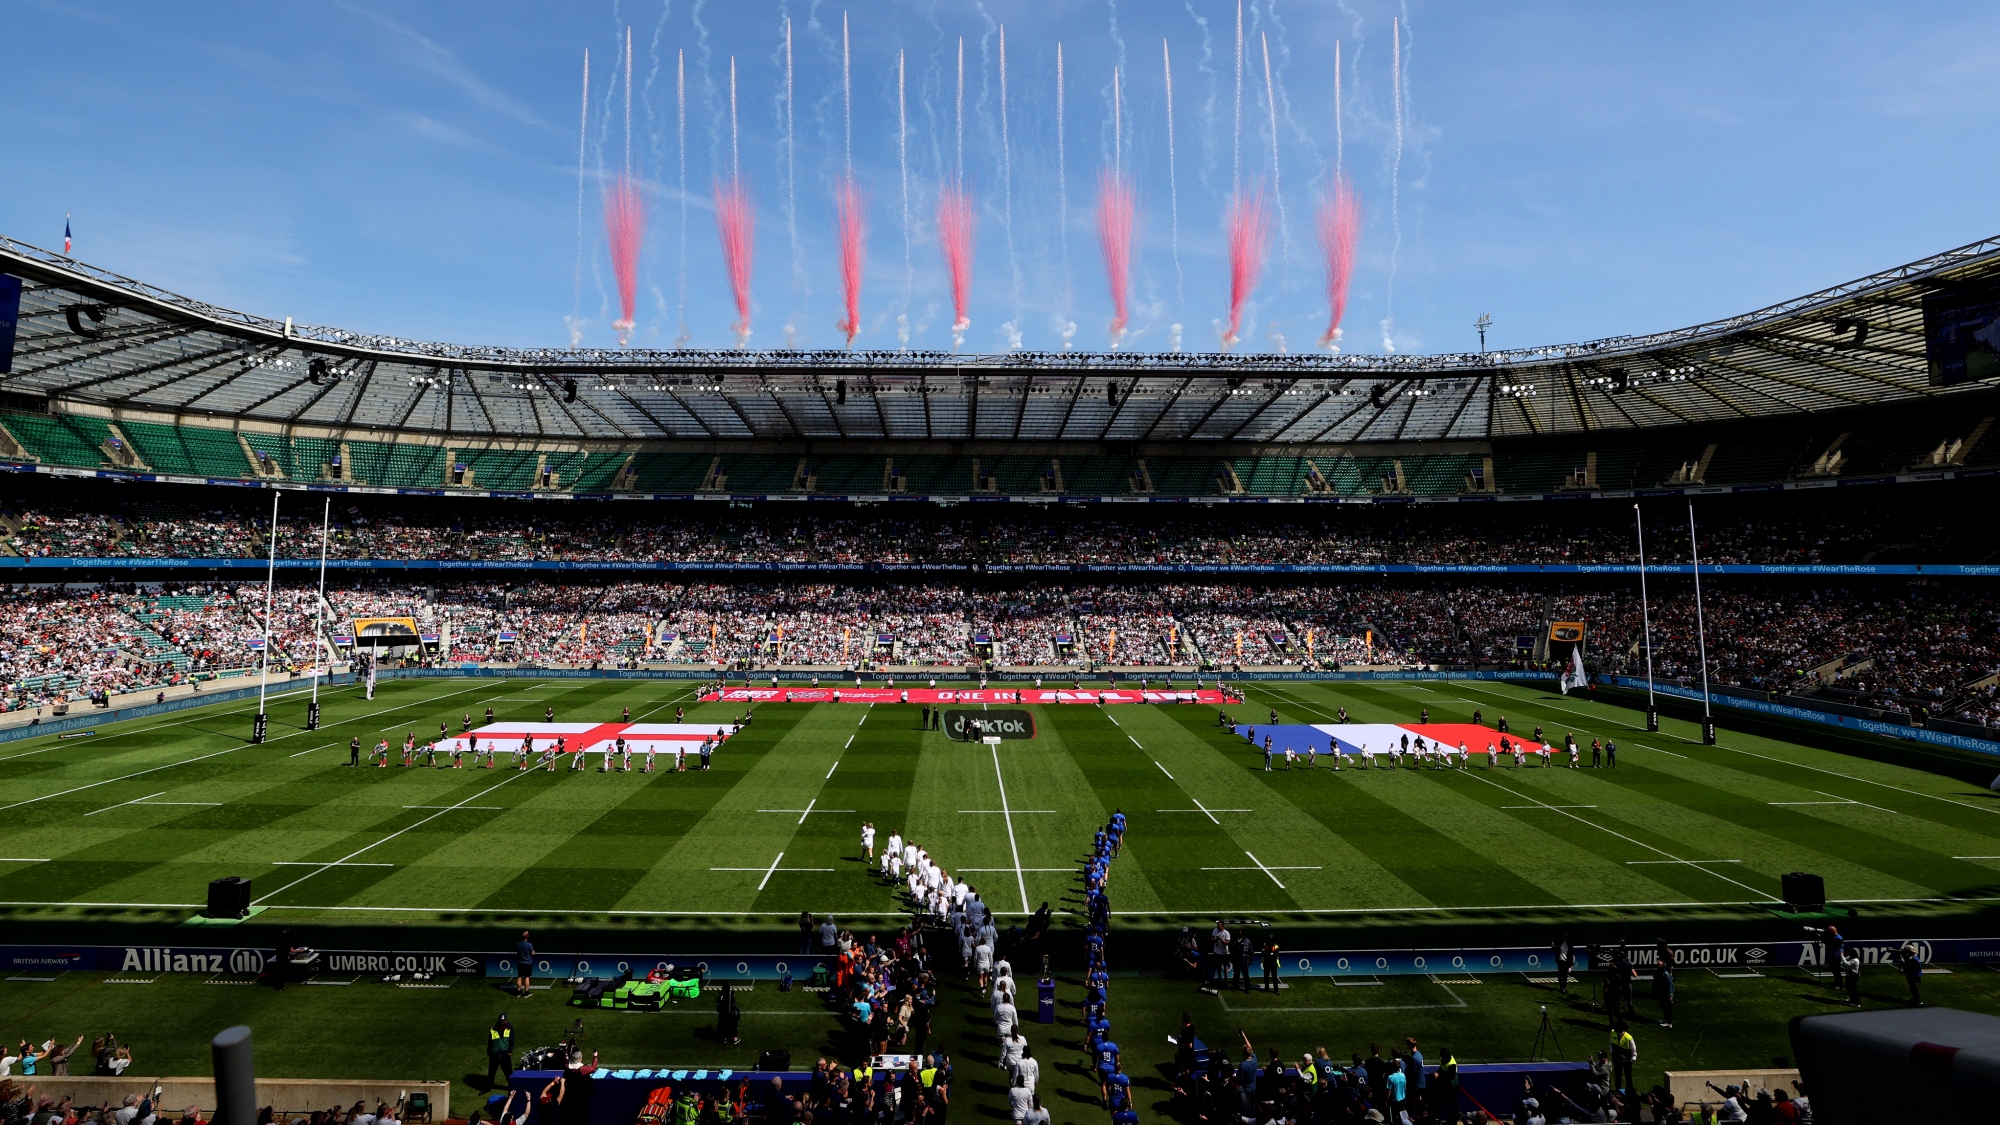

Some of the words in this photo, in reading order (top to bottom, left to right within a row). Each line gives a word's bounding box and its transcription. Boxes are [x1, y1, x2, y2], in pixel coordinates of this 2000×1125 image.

[72, 558, 110, 568] Together
[128, 558, 188, 566] #WearTheRose
[439, 560, 469, 569] Together
[483, 560, 533, 568] #WearTheRose
[572, 561, 600, 570] Together
[675, 561, 702, 570] Together
[714, 561, 760, 569] #WearTheRose
[778, 562, 806, 571] Together
[882, 563, 909, 572] Together
[985, 564, 1012, 572] Together
[1088, 564, 1115, 572] Together
[1292, 564, 1319, 573] Together
[1415, 565, 1444, 573] Together
[1577, 565, 1610, 573] Together
[1760, 565, 1795, 574] Together
[1812, 565, 1875, 573] #WearTheRose
[412, 668, 465, 676] #WearTheRose
[538, 669, 591, 677] #WearTheRose
[618, 670, 653, 679] Together
[665, 670, 718, 678] #WearTheRose
[745, 672, 778, 680] Together
[791, 672, 844, 680] #WearTheRose
[871, 672, 903, 680] Together
[918, 672, 971, 680] #WearTheRose
[1372, 672, 1404, 681] Together
[1493, 671, 1524, 680] Together
[998, 673, 1031, 681] Together
[1044, 673, 1097, 681] #WearTheRose
[1124, 673, 1156, 682] Together
[1170, 673, 1222, 681] #WearTheRose
[1249, 673, 1281, 682] Together
[1294, 672, 1345, 680] #WearTheRose
[937, 692, 985, 700] ONE
[1662, 684, 1704, 699] #WearTheRose
[132, 703, 166, 717] Together
[168, 700, 179, 709] we
[181, 693, 230, 708] #WearTheRose
[1727, 696, 1756, 709] Together
[1758, 703, 1769, 711] we
[1771, 704, 1825, 722] #WearTheRose
[12, 729, 28, 740] we
[31, 716, 100, 735] #WearTheRose
[1857, 718, 1898, 735] Together
[1901, 728, 1917, 738] we
[1919, 729, 1998, 753] #WearTheRose
[122, 948, 223, 972] Allianz
[329, 955, 447, 972] UMBRO.CO.UK
